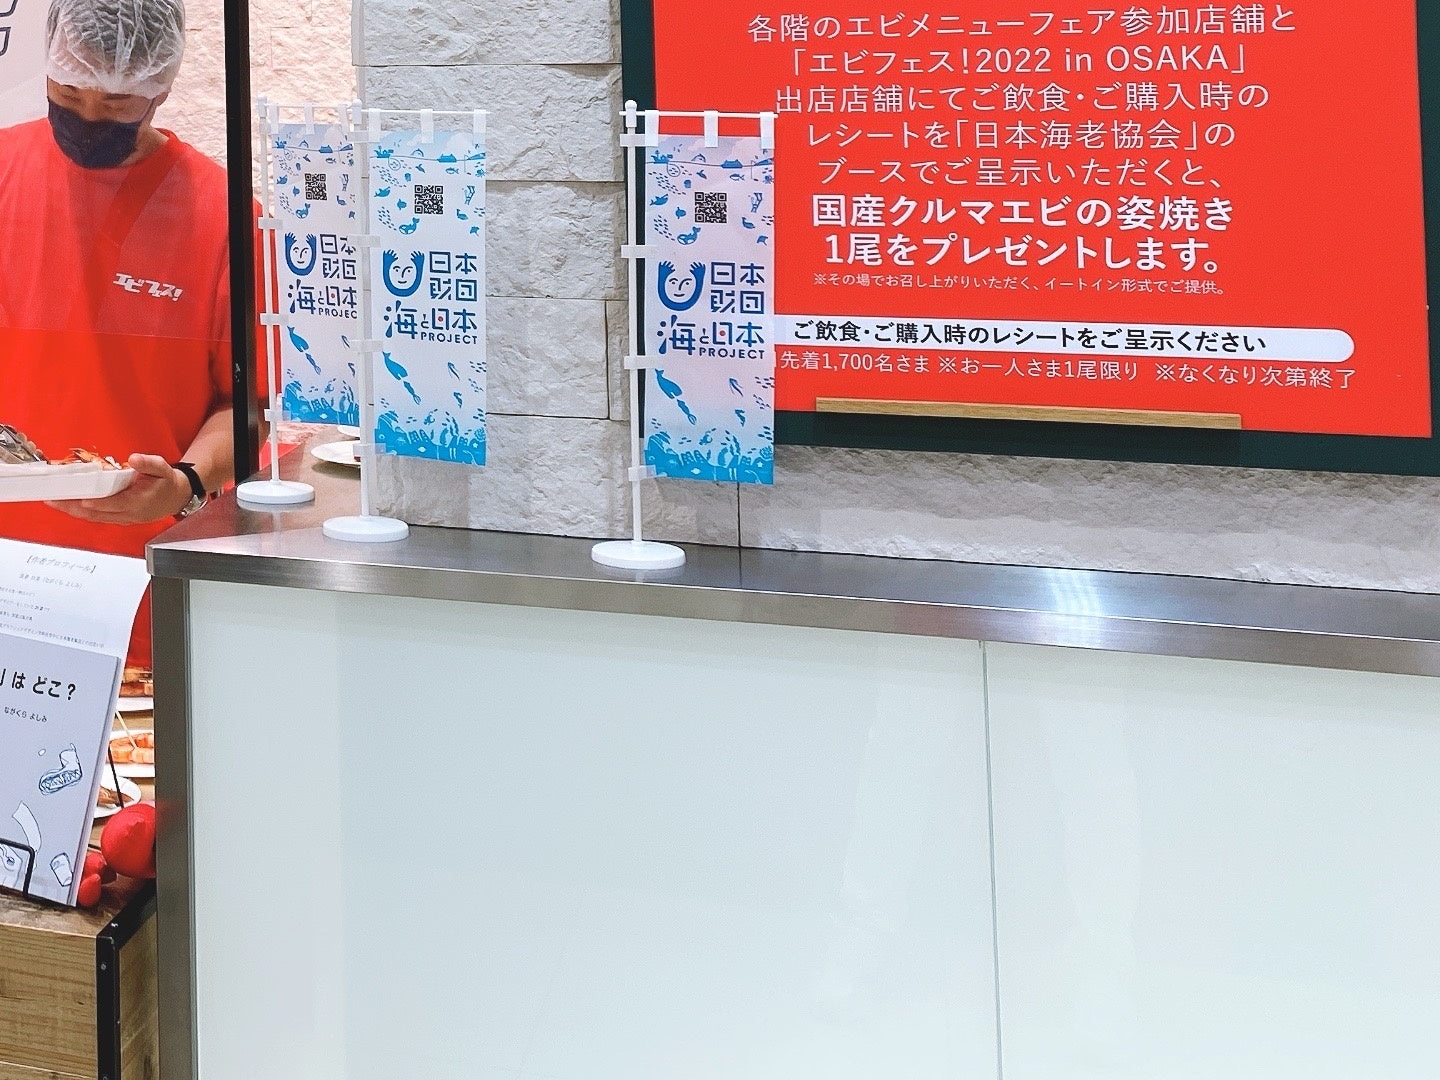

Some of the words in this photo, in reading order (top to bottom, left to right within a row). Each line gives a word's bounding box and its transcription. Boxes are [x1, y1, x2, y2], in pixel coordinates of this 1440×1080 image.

[747, 3, 1297, 43] 各階のエビメニューフェア参加店舗と
[1064, 47, 1093, 72] in
[775, 81, 1270, 115] 出店店舗にてご飲食・ご購入時の
[807, 120, 1236, 152] レシートを「日本海老協会」の
[818, 158, 1223, 188] ブースでご呈示いただくと、
[810, 193, 1234, 232] 国産クルマエビの姿焼き
[429, 251, 478, 274] 日本
[824, 232, 1219, 274] 1尾をプレゼントします。
[710, 262, 765, 286] 日本
[429, 277, 478, 302] 財団
[710, 289, 765, 314] 財団
[318, 307, 358, 319] PROJEC
[383, 300, 478, 339] 海と日本
[420, 331, 478, 345] PROJECT
[657, 315, 765, 355] 海と日本
[793, 319, 1267, 353] ご飲食・ご購入時のレシートをご呈示ください
[699, 347, 765, 359] PROJECT
[773, 350, 930, 375] 先着1,700名さま
[12, 671, 26, 689] は
